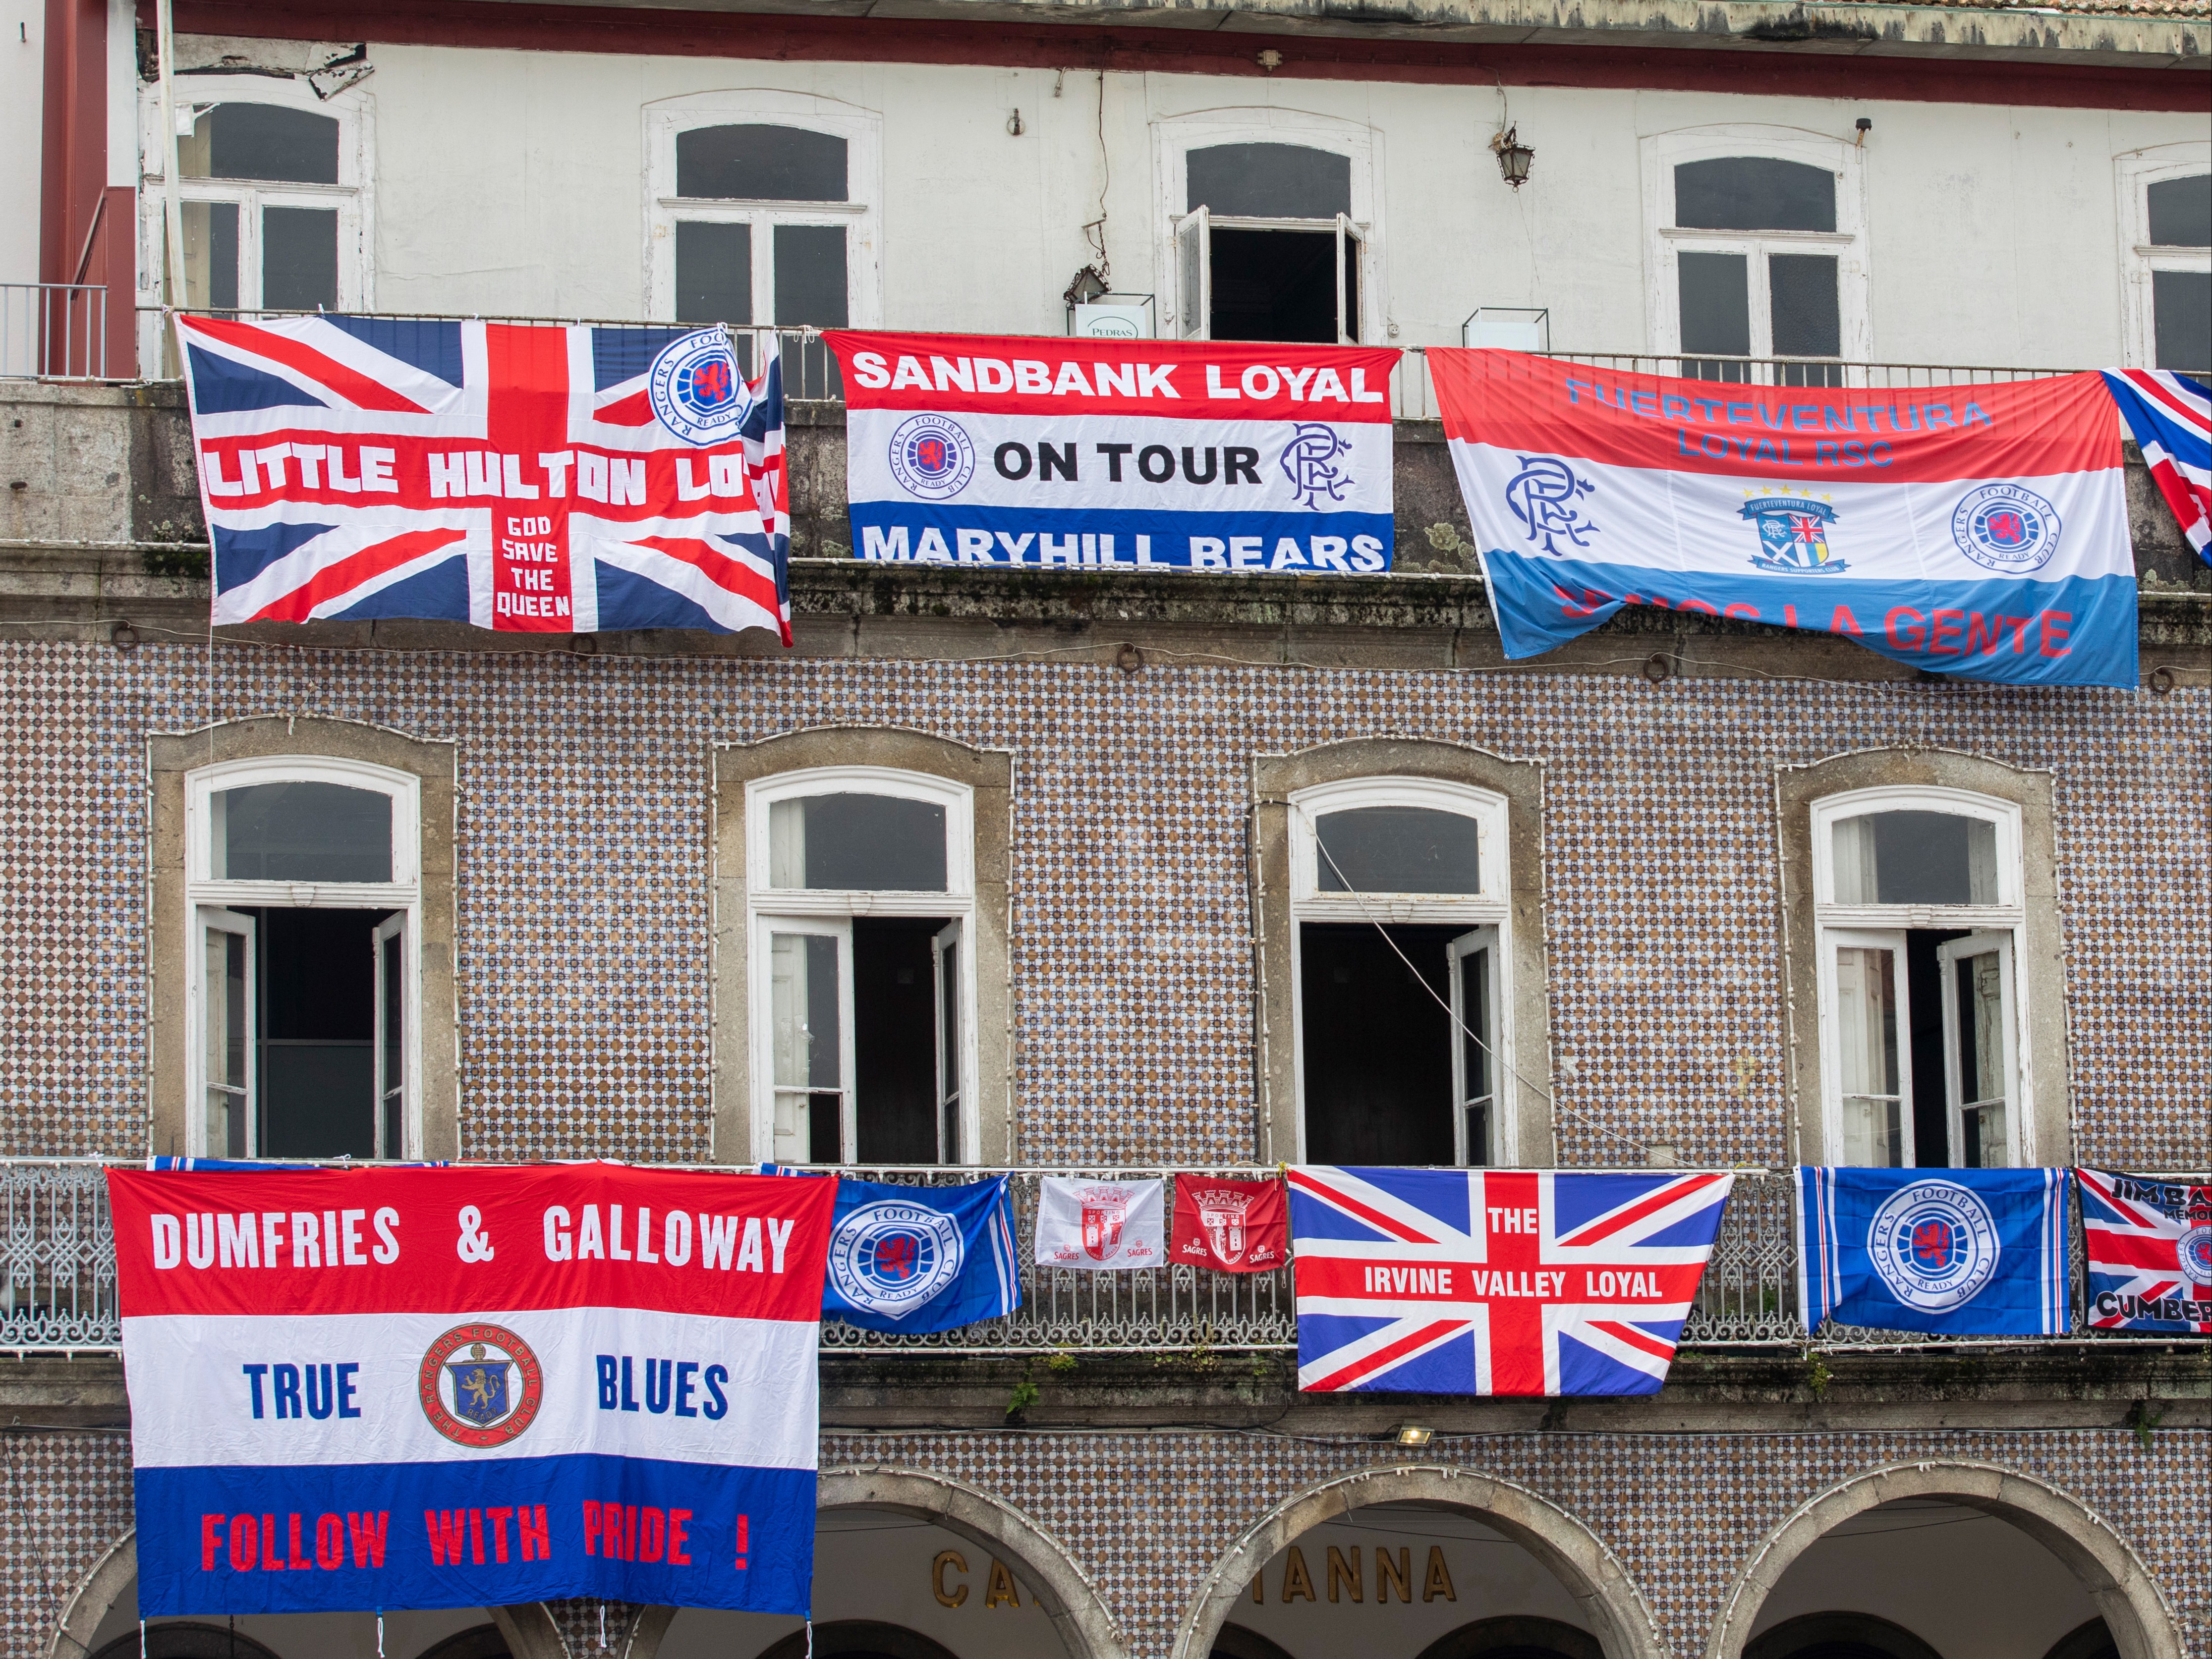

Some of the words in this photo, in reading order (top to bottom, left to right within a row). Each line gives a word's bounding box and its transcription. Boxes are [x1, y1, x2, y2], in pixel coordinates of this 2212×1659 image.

[1093, 328, 1132, 337] PEDRAS
[853, 352, 1181, 399] SANDBANK
[1207, 365, 1384, 403] LOYAL
[655, 358, 692, 436] RANGERS
[1565, 377, 1993, 433] FUERTEVENTURA
[697, 412, 730, 426] READY
[892, 432, 917, 491] RANGERS
[915, 417, 970, 452] FOOTBALL
[948, 466, 971, 493] CLUB
[1678, 428, 1803, 466] LOYAL
[1816, 440, 1894, 468] RSC
[203, 442, 399, 496] LITTLE
[428, 450, 646, 505] HULTON
[993, 441, 1077, 481] ON
[1097, 443, 1263, 485] TOUR
[921, 479, 945, 487] READY
[1750, 500, 1804, 511] FUERTEVENTURA
[1807, 504, 1826, 515] LOYAL
[507, 516, 551, 536] GOD
[1956, 507, 1996, 567] RANGERS
[1979, 487, 2052, 520] FOOTBALL
[2034, 532, 2058, 564] CLUB
[502, 538, 558, 562] SAVE
[862, 526, 1169, 571] MARYHILL
[1189, 535, 1385, 573] BEARS
[1999, 551, 2029, 560] READY
[511, 567, 554, 591] THE
[1762, 563, 1788, 572] RANGERS
[497, 592, 570, 618] QUEEN
[1884, 606, 2072, 658] GENTE
[2111, 1178, 2160, 1203] JIM
[1488, 1207, 1537, 1234] THE
[150, 1207, 401, 1270] DUMFRIES
[457, 1204, 494, 1263] &
[543, 1203, 795, 1274] GALLOWAY
[1127, 1248, 1152, 1257] SAGRES
[1182, 1244, 1207, 1256] SAGRES
[1876, 1212, 1913, 1297] RANGERS
[1912, 1188, 1987, 1238] FOOTBALL
[1957, 1258, 1990, 1298] CLUB
[835, 1226, 874, 1305] RANGERS
[874, 1208, 953, 1247] FOOTBALL
[922, 1259, 954, 1301] CLUB
[1054, 1251, 1079, 1260] SAGRES
[1250, 1251, 1274, 1263] SAGRES
[2178, 1241, 2198, 1281] RANGERS
[879, 1287, 918, 1299] READY
[1365, 1266, 1452, 1294] IRVINE
[1472, 1270, 1566, 1297] VALLEY
[1586, 1271, 1662, 1298] LOYAL
[1917, 1279, 1953, 1290] READY
[425, 1333, 463, 1404] RANGERS
[473, 1329, 537, 1387] FOOTBALL
[243, 1363, 361, 1420] TRUE
[596, 1354, 729, 1420] BLUES
[433, 1411, 460, 1437] THE
[467, 1407, 497, 1420] READY
[505, 1398, 536, 1434] CLUB
[201, 1510, 389, 1572] FOLLOW
[425, 1504, 550, 1566] WITH
[583, 1500, 693, 1565] PRIDE
